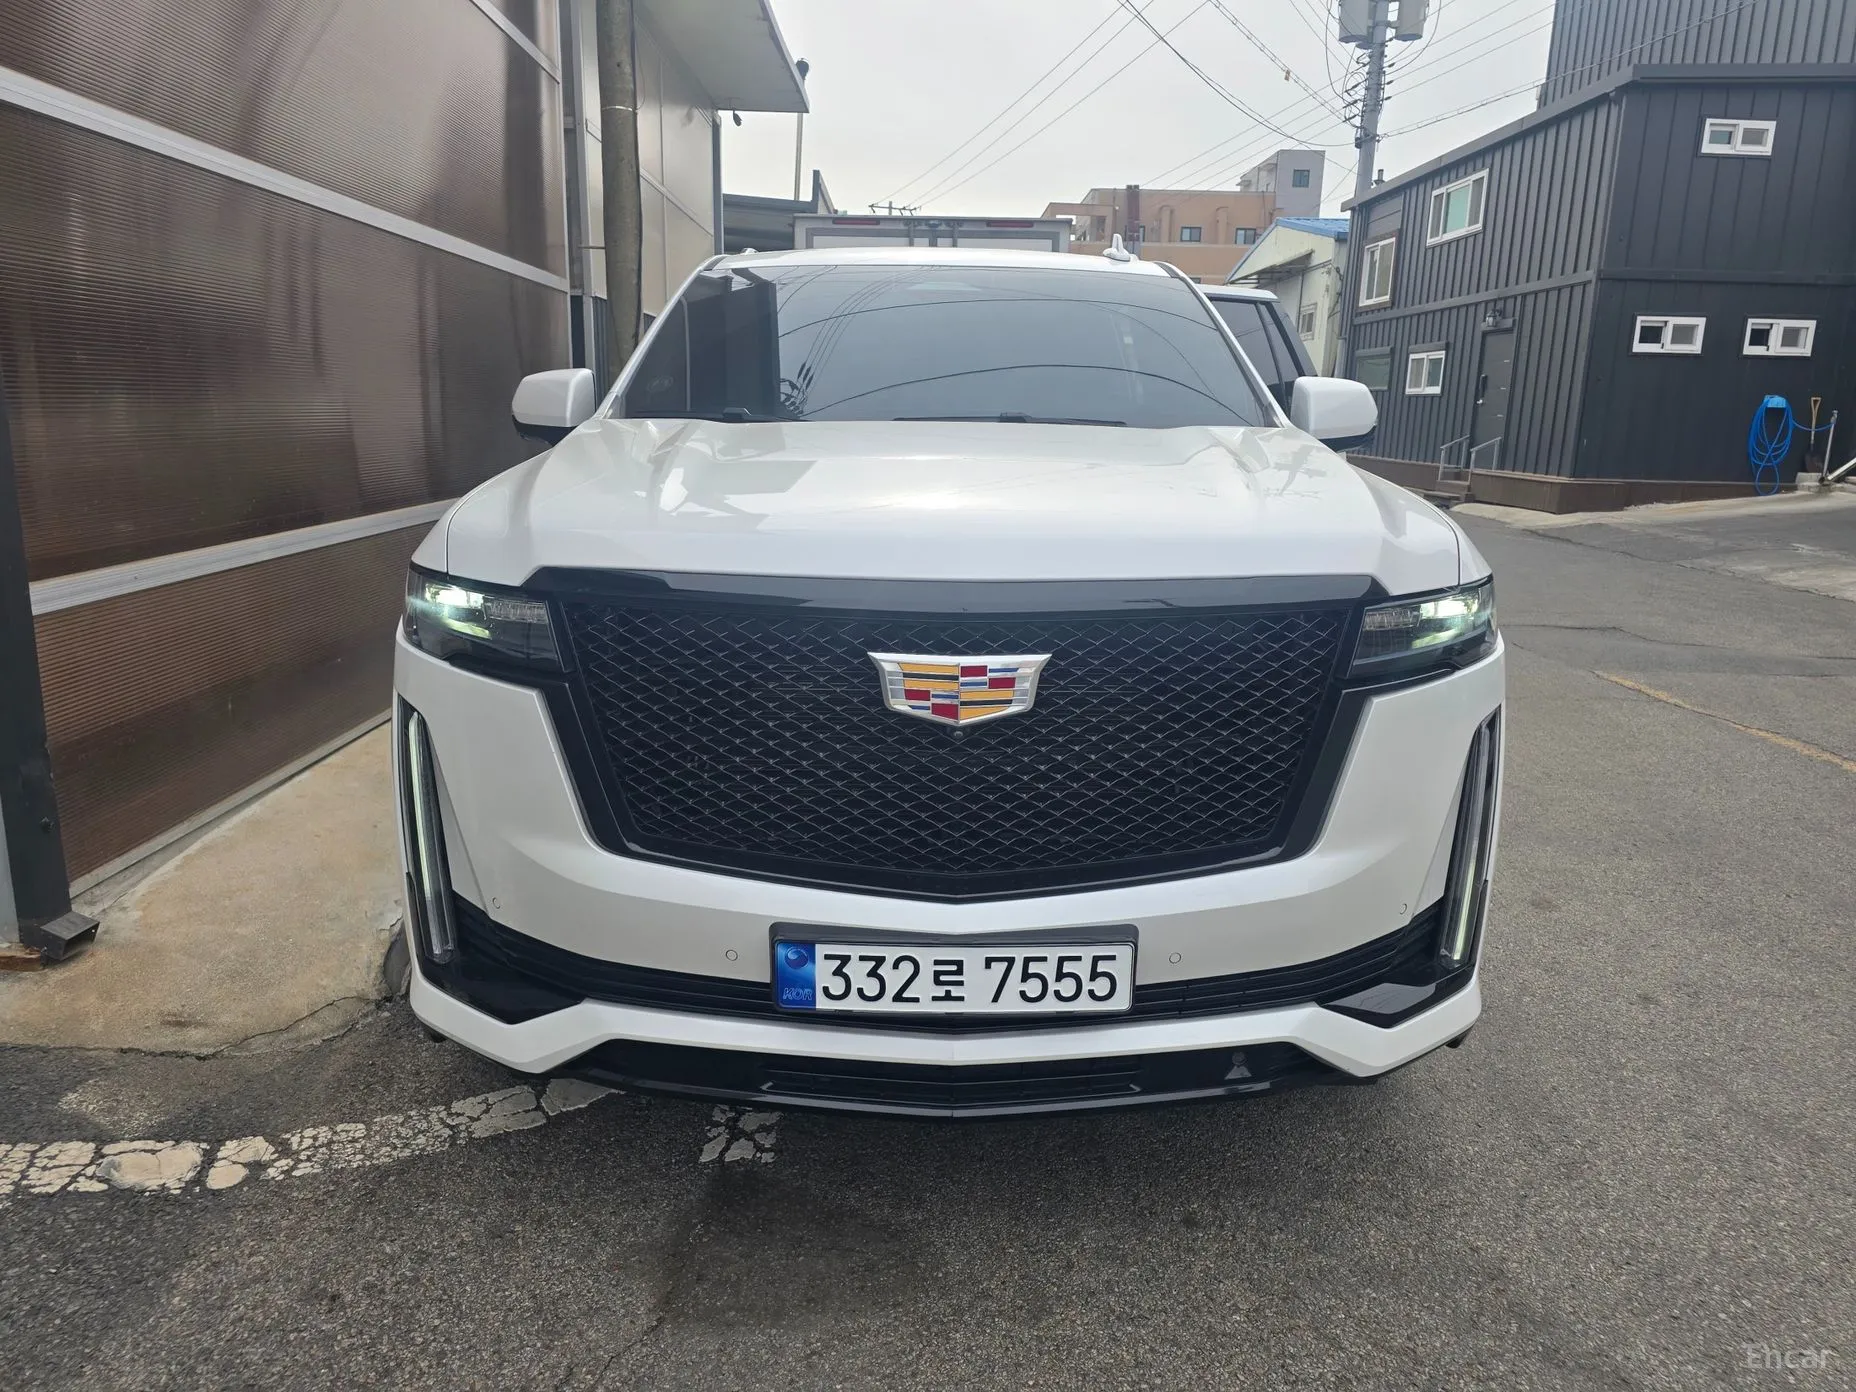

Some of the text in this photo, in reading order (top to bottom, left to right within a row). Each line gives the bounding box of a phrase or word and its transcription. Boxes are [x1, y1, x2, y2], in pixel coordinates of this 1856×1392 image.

[782, 987, 813, 1001] KOR
[822, 954, 1118, 1003] 332로 7555
